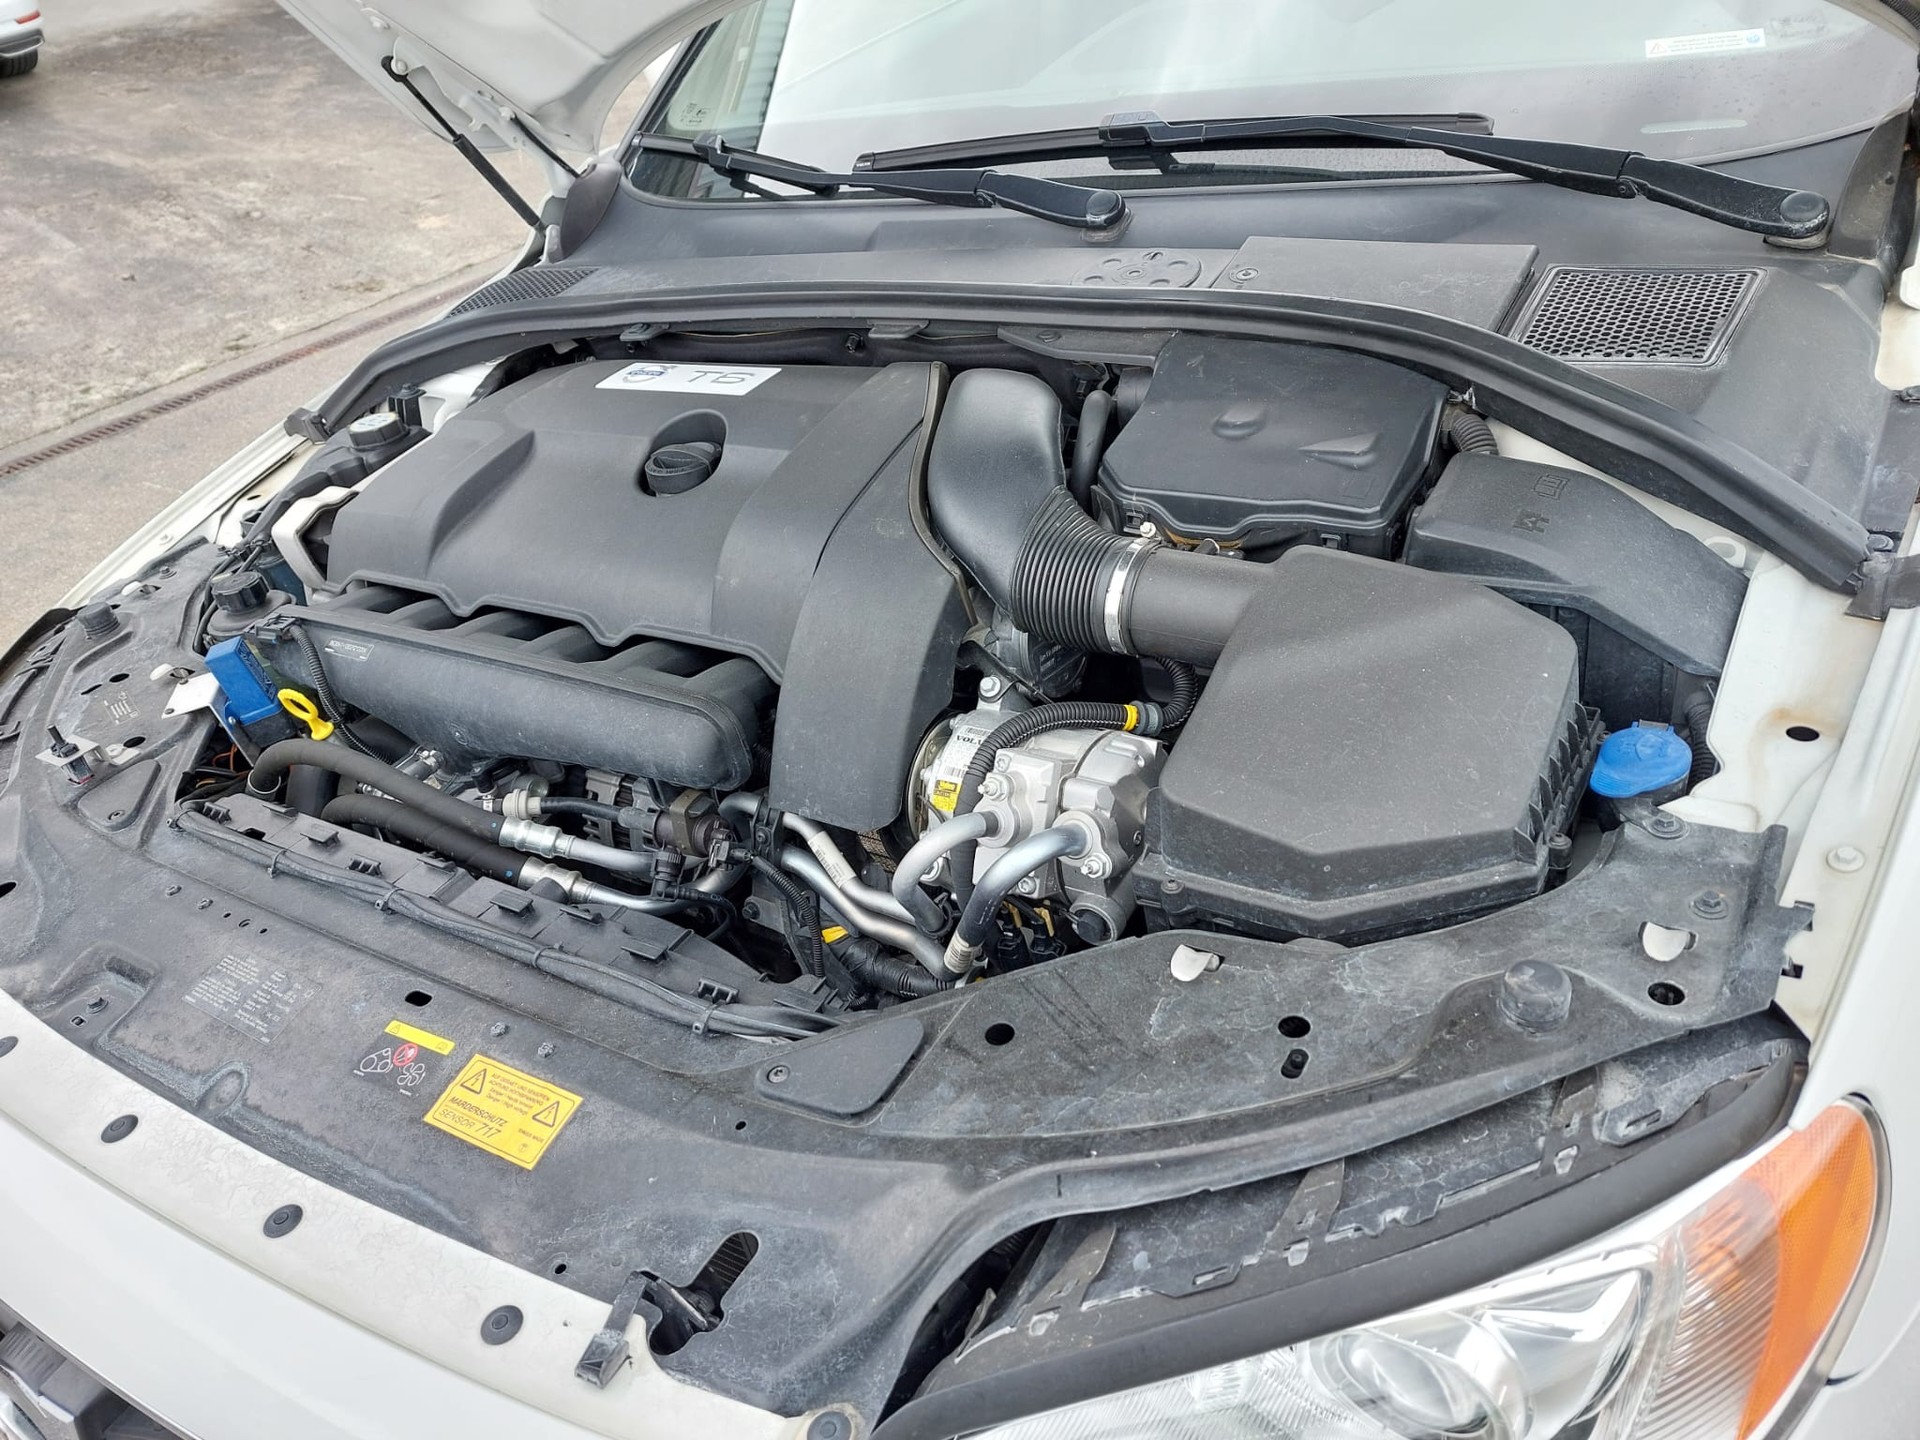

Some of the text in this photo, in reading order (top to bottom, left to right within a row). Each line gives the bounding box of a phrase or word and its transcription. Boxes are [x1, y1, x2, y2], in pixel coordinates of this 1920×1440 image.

[688, 370, 756, 384] T6
[956, 734, 982, 745] VOLV
[449, 1096, 508, 1127] MARDERSCHUTZ
[440, 1108, 502, 1139] SENSOR 717
